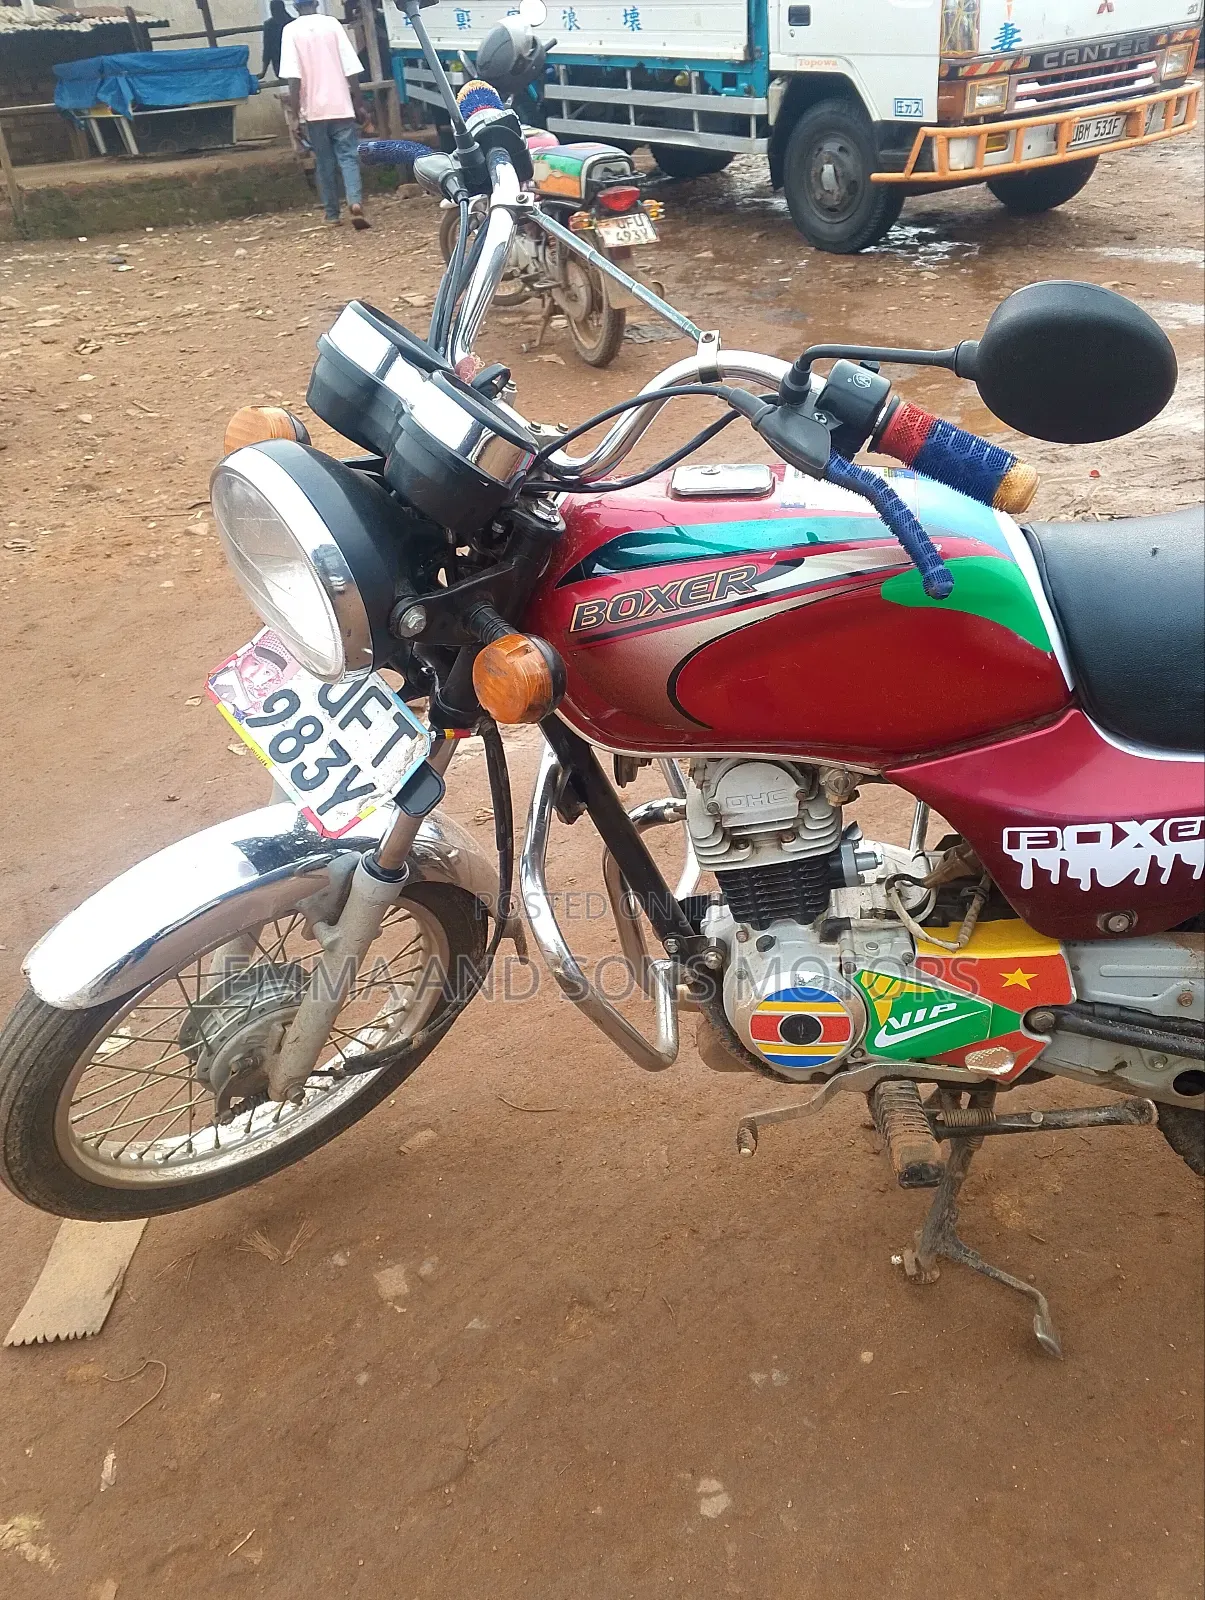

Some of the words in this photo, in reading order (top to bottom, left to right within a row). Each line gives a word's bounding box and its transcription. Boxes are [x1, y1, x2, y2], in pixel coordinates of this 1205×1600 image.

[1043, 36, 1150, 70] CANTER
[1094, 117, 1121, 138] 531F
[569, 564, 758, 633] BOXER
[245, 688, 377, 817] 983Y
[887, 1002, 957, 1030] VIP
